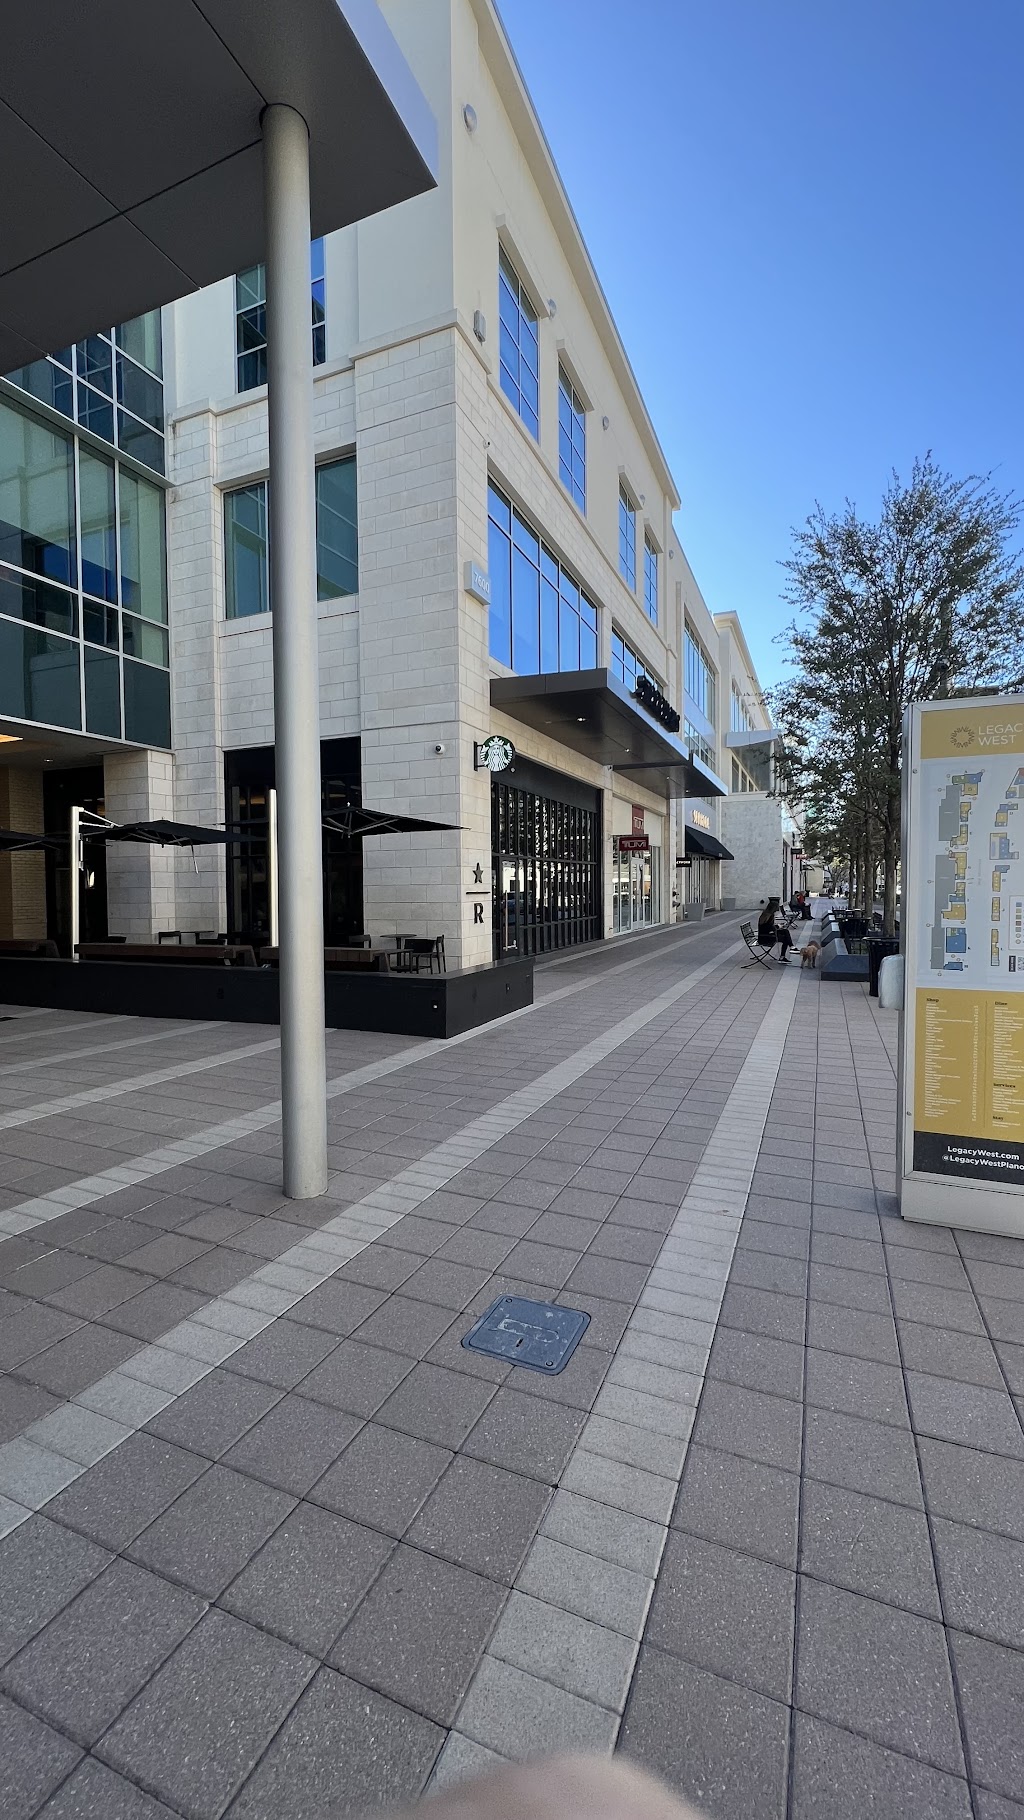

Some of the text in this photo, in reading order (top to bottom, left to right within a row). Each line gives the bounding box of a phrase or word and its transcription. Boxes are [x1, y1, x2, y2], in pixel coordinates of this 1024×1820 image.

[978, 723, 1024, 735] LEGAC
[978, 734, 1017, 746] WEST
[621, 840, 647, 848] TUMI
[473, 902, 484, 924] R
[947, 1145, 1020, 1161] LegacyWest.com
[941, 1153, 1024, 1171] @LegacyWestPlano
